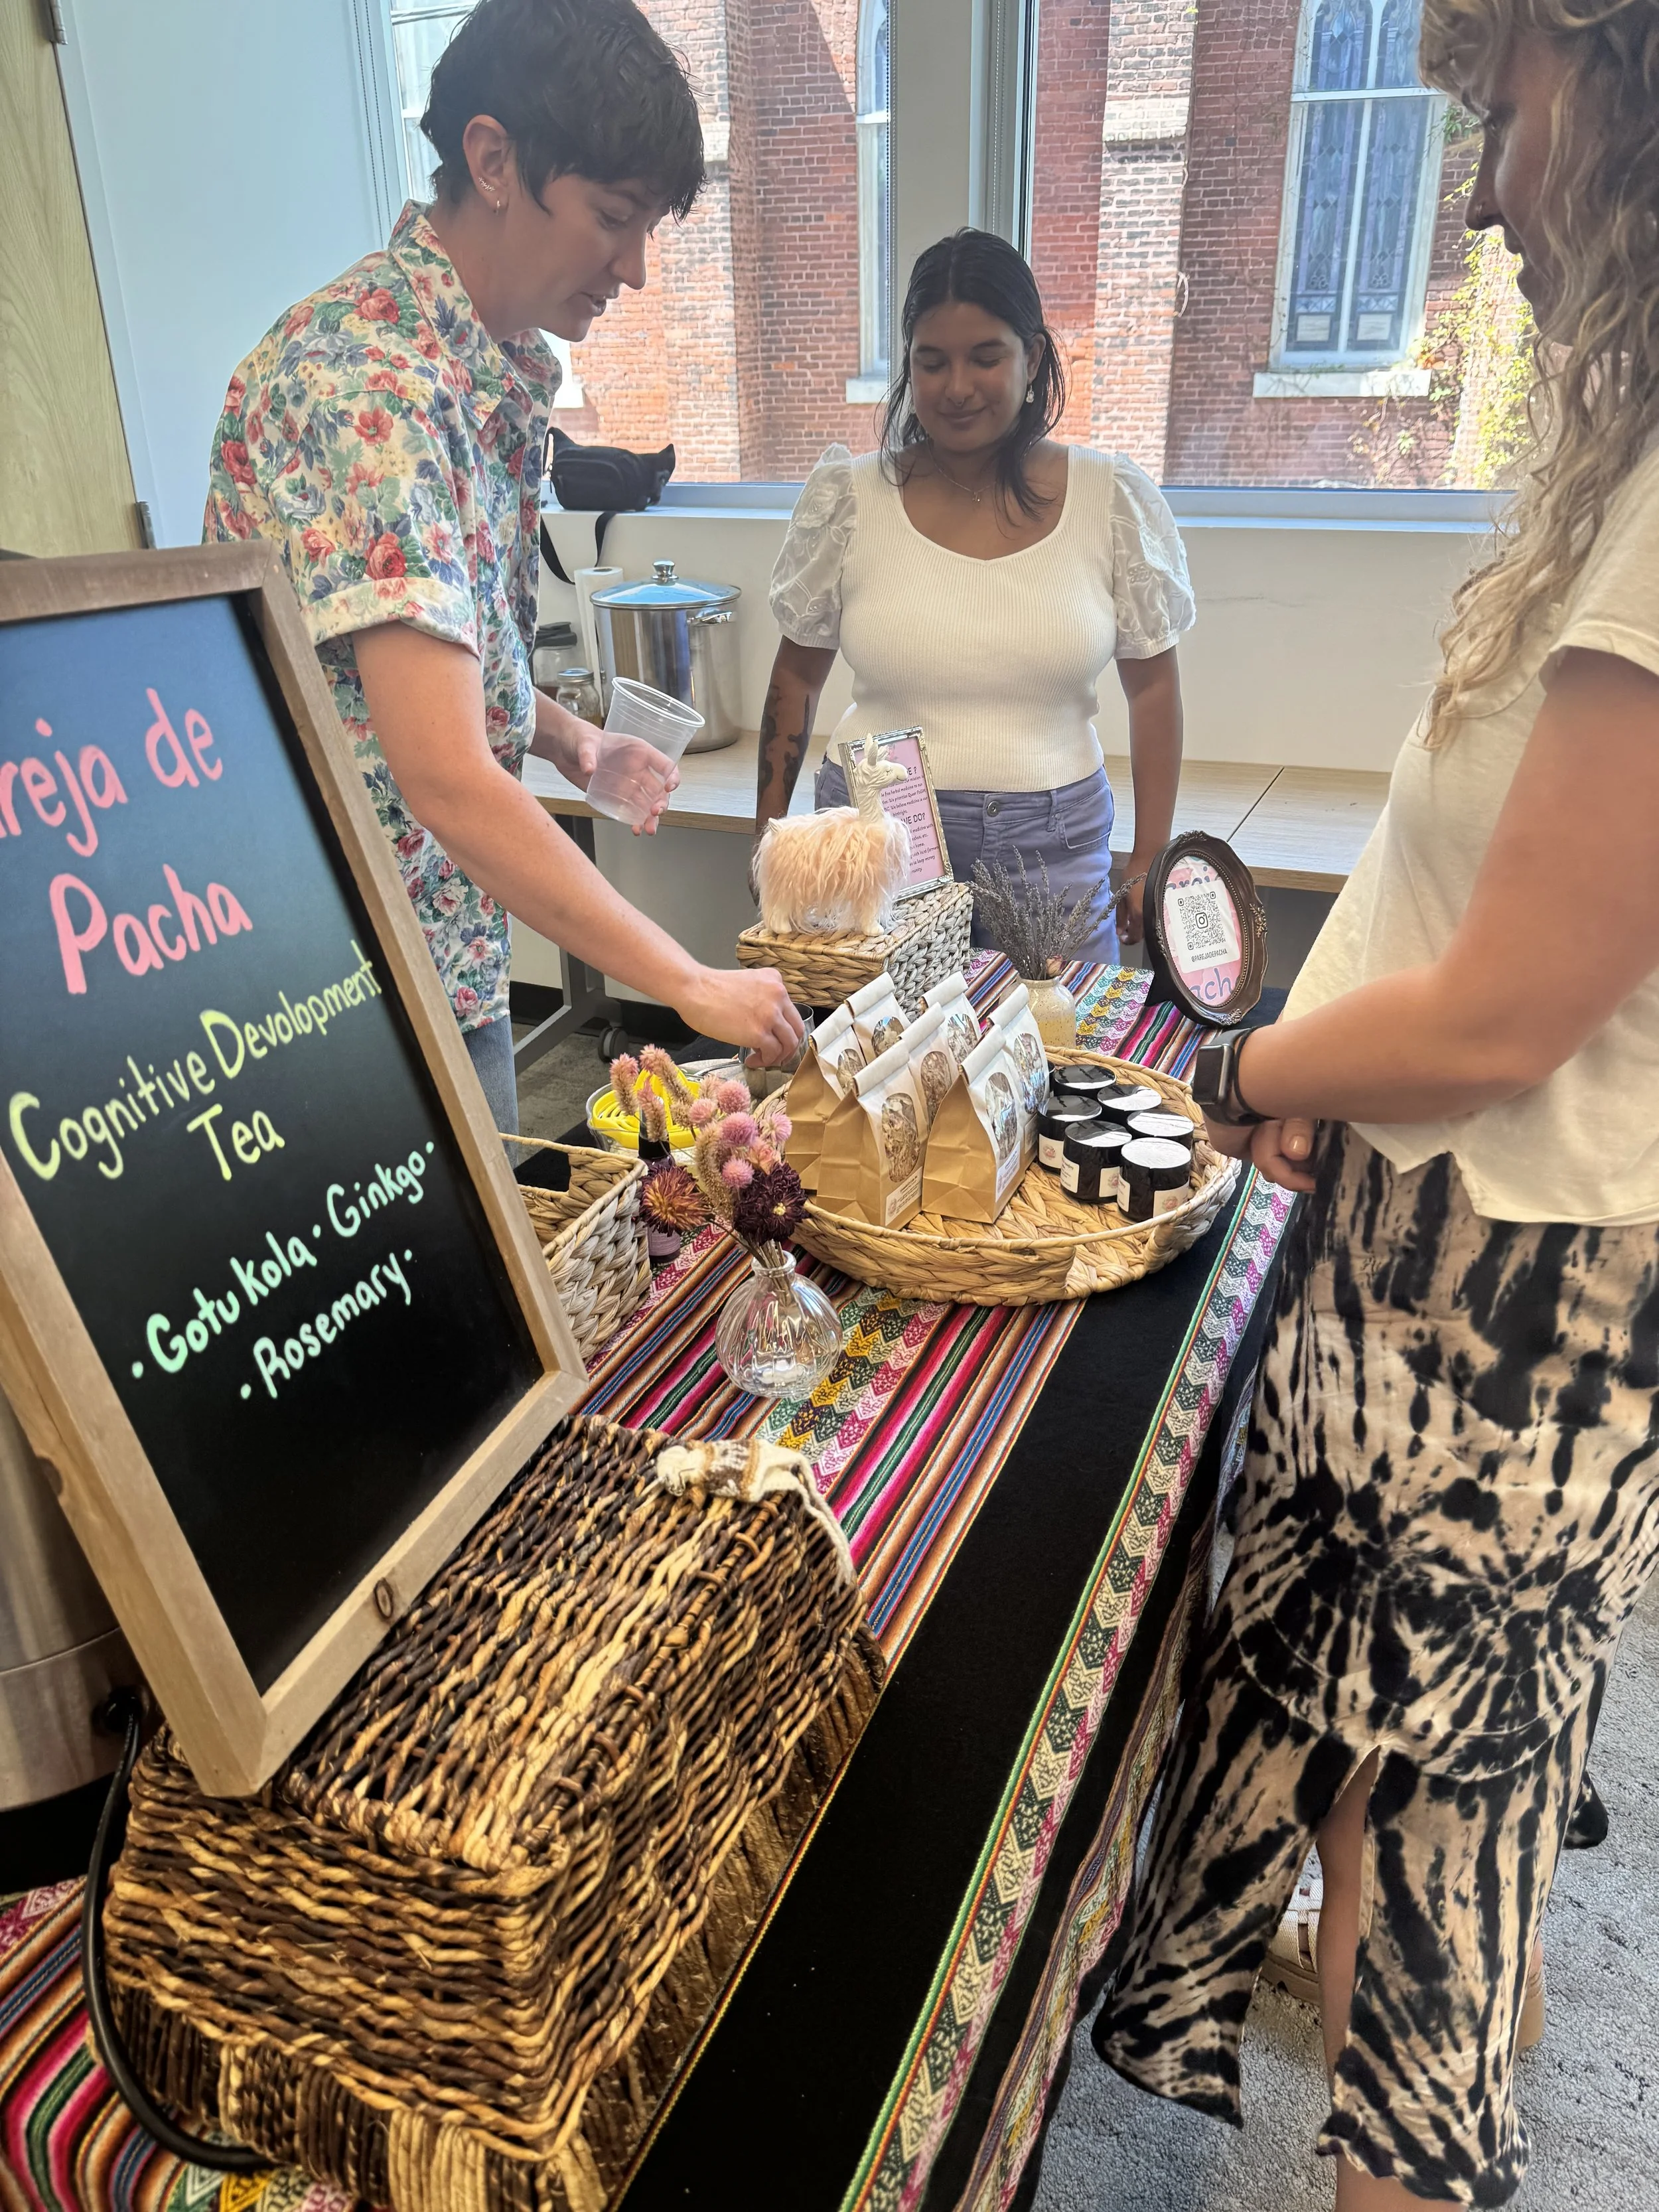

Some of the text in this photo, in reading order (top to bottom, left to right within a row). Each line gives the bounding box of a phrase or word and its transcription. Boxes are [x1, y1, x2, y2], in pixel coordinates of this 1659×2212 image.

[0, 688, 222, 857] reja de
[913, 812, 926, 823] DO?
[50, 865, 252, 994] Pacha
[9, 939, 382, 1181] Cognitive Devolopment
[186, 1103, 285, 1181] Tea
[147, 1288, 240, 1373] Gotu
[326, 1151, 426, 1237] Ginkgo
[253, 1252, 411, 1398] Rosemary
